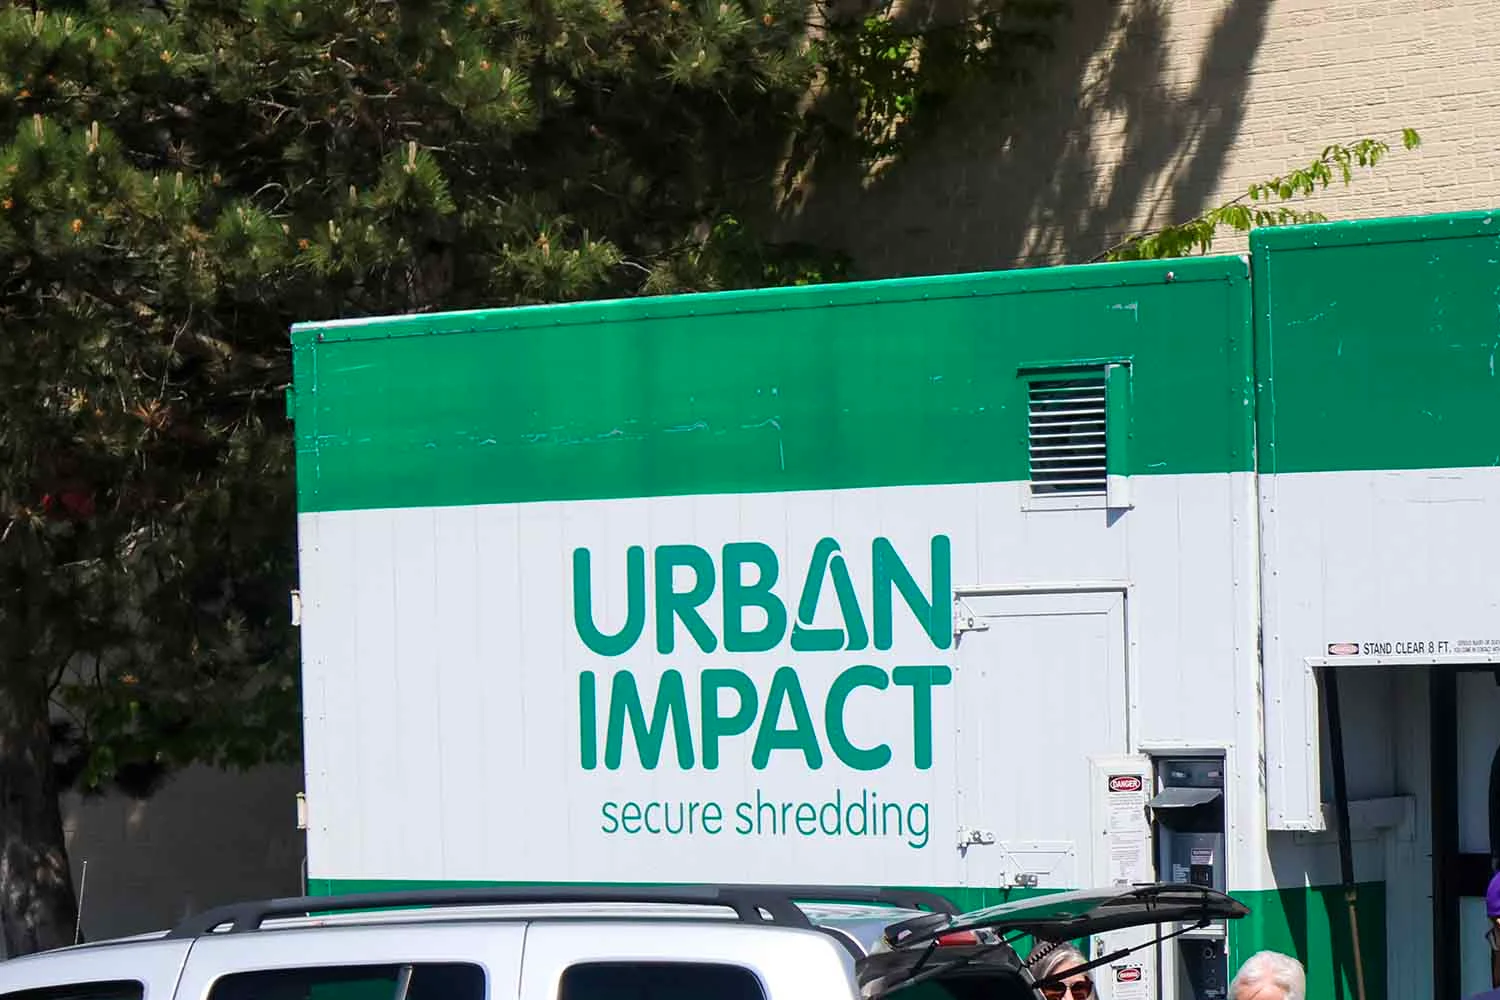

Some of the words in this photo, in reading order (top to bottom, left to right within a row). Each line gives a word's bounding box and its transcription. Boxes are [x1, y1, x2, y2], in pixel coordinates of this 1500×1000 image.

[573, 534, 952, 656] URBAN
[1363, 642, 1392, 655] STAND
[1395, 641, 1425, 654] CLEAR
[1428, 641, 1435, 653] 8
[579, 665, 952, 770] IMPACT
[601, 800, 722, 835] secure
[735, 788, 930, 849] shredding
